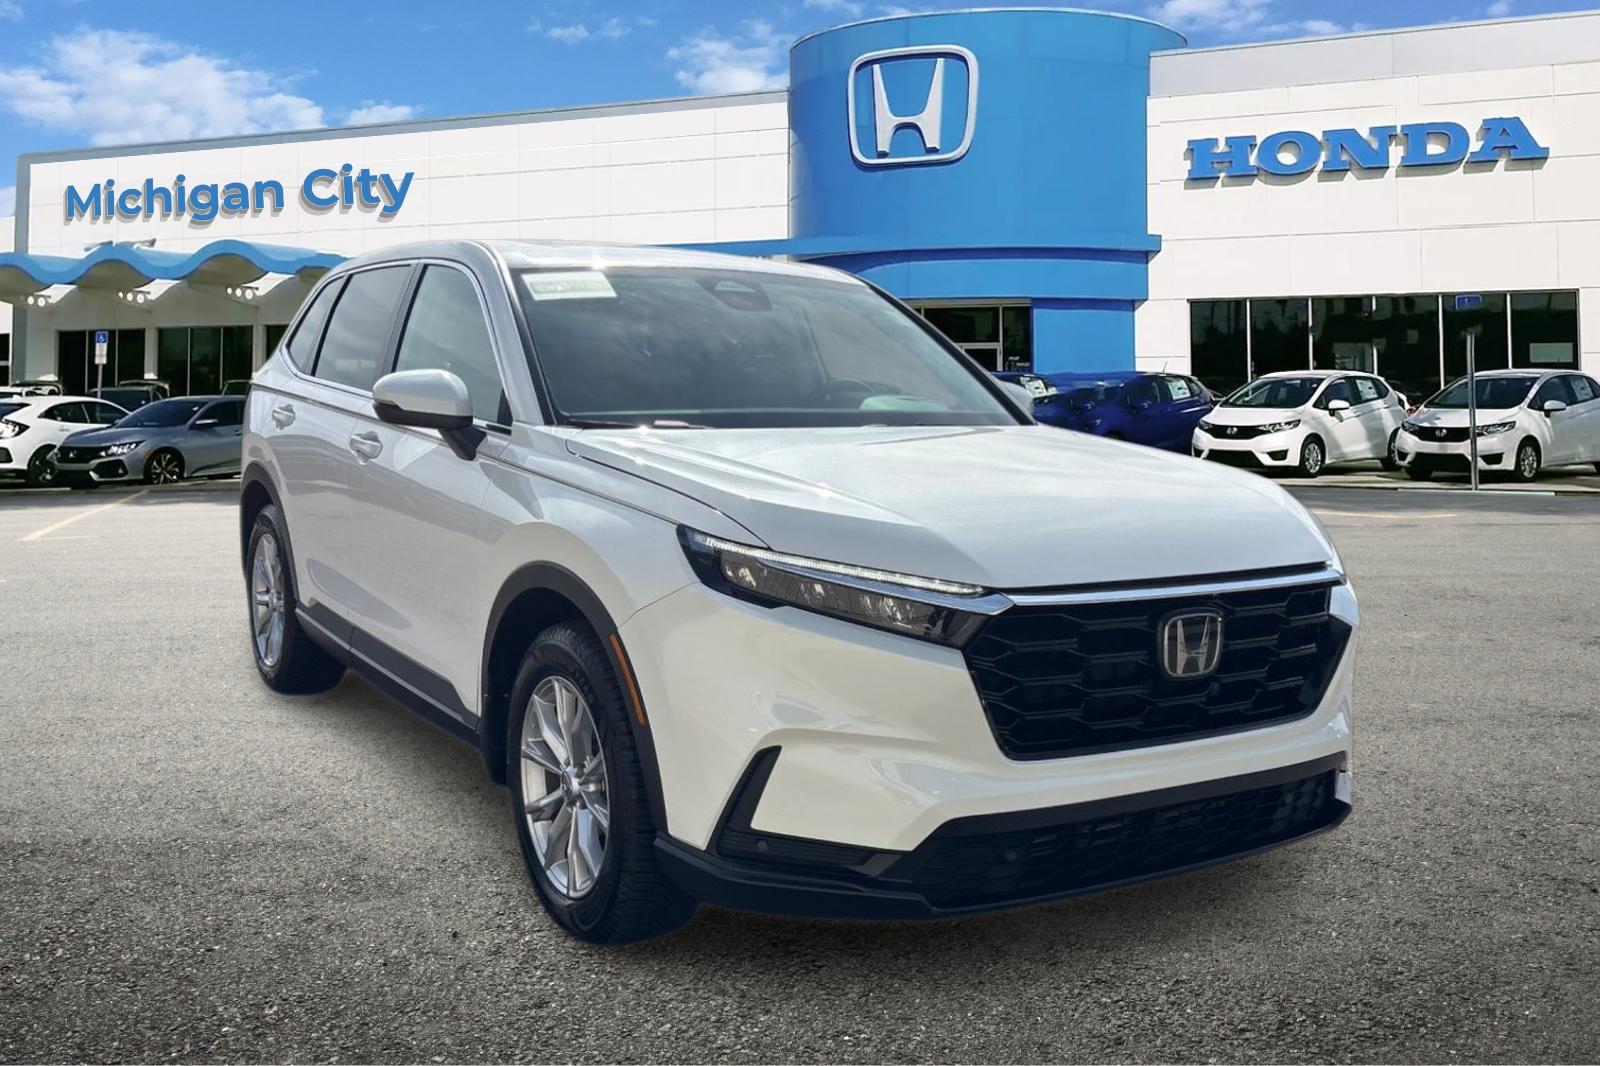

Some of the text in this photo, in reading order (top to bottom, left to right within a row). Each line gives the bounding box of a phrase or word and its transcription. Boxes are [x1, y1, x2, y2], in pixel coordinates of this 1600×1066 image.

[1187, 116, 1550, 181] HONDA
[66, 163, 415, 222] Michigan City
